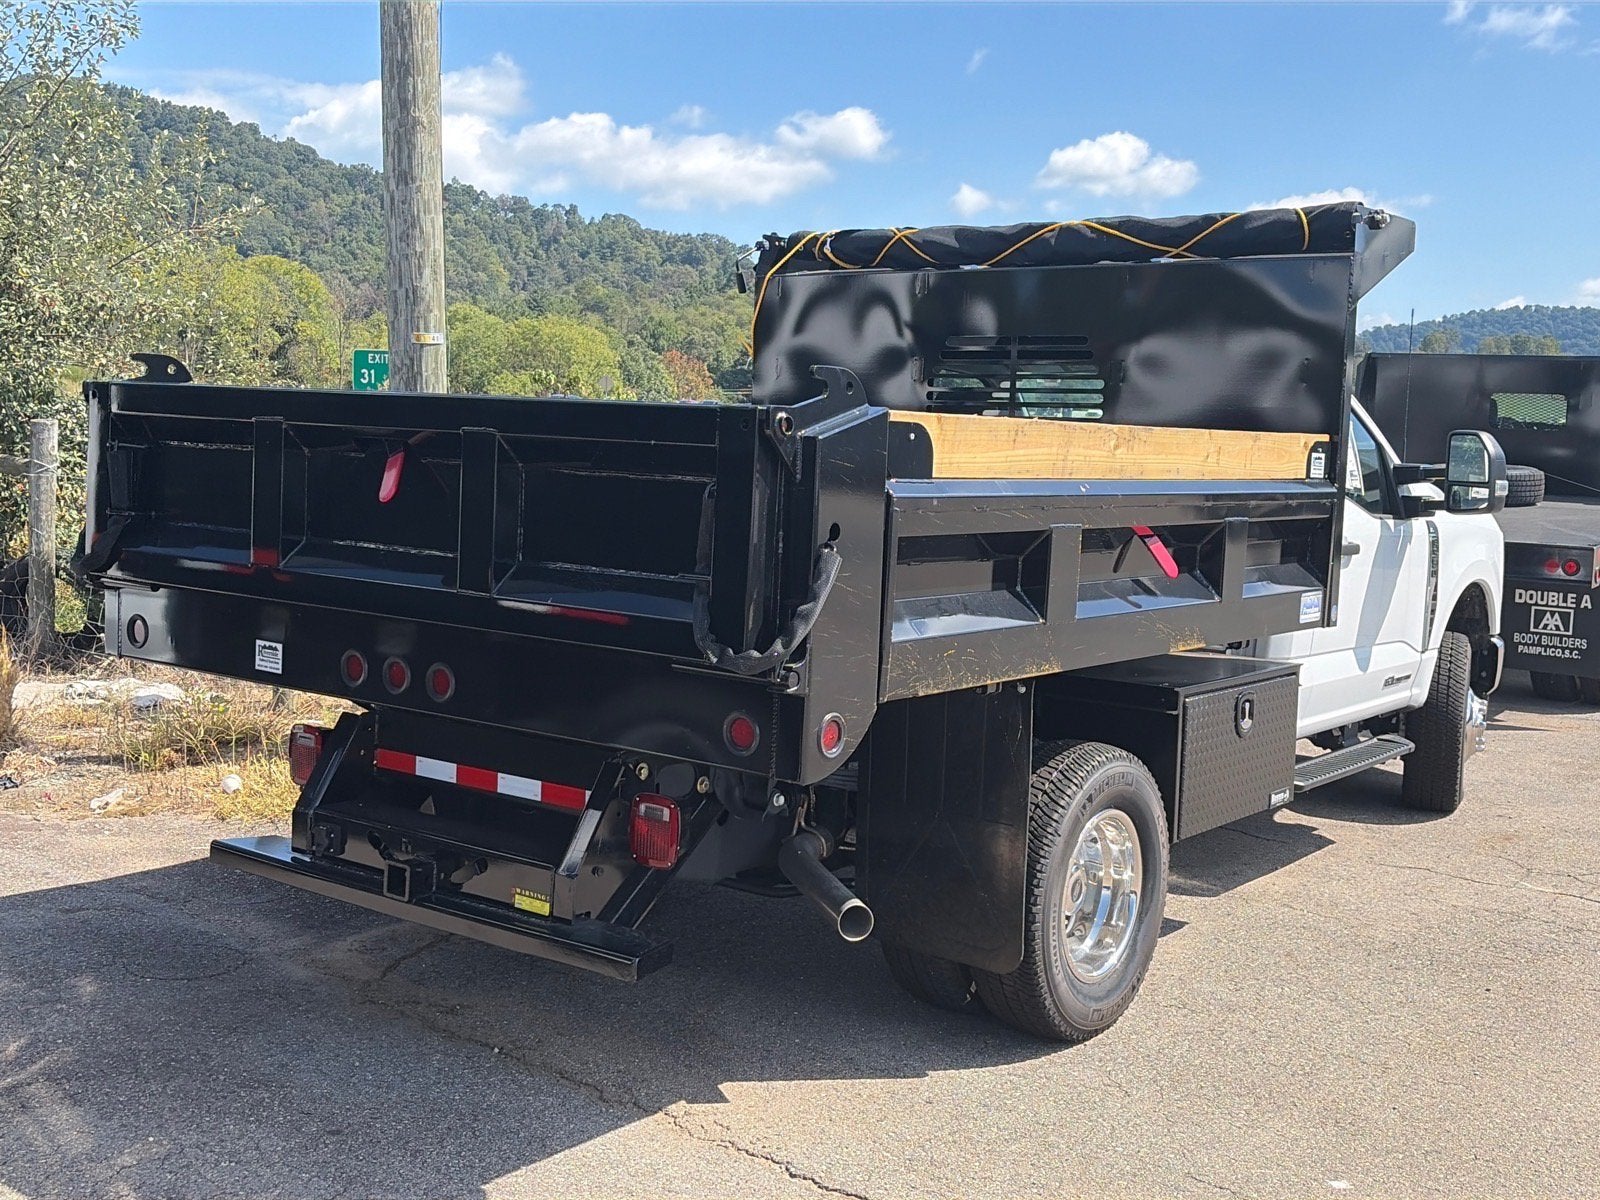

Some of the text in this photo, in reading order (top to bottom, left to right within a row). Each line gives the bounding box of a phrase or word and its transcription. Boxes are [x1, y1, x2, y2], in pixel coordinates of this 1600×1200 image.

[368, 354, 389, 364] EXIT
[360, 369, 375, 384] 31
[1514, 588, 1592, 609] DOUBLE A
[1513, 632, 1588, 650] BODY BUILDERS
